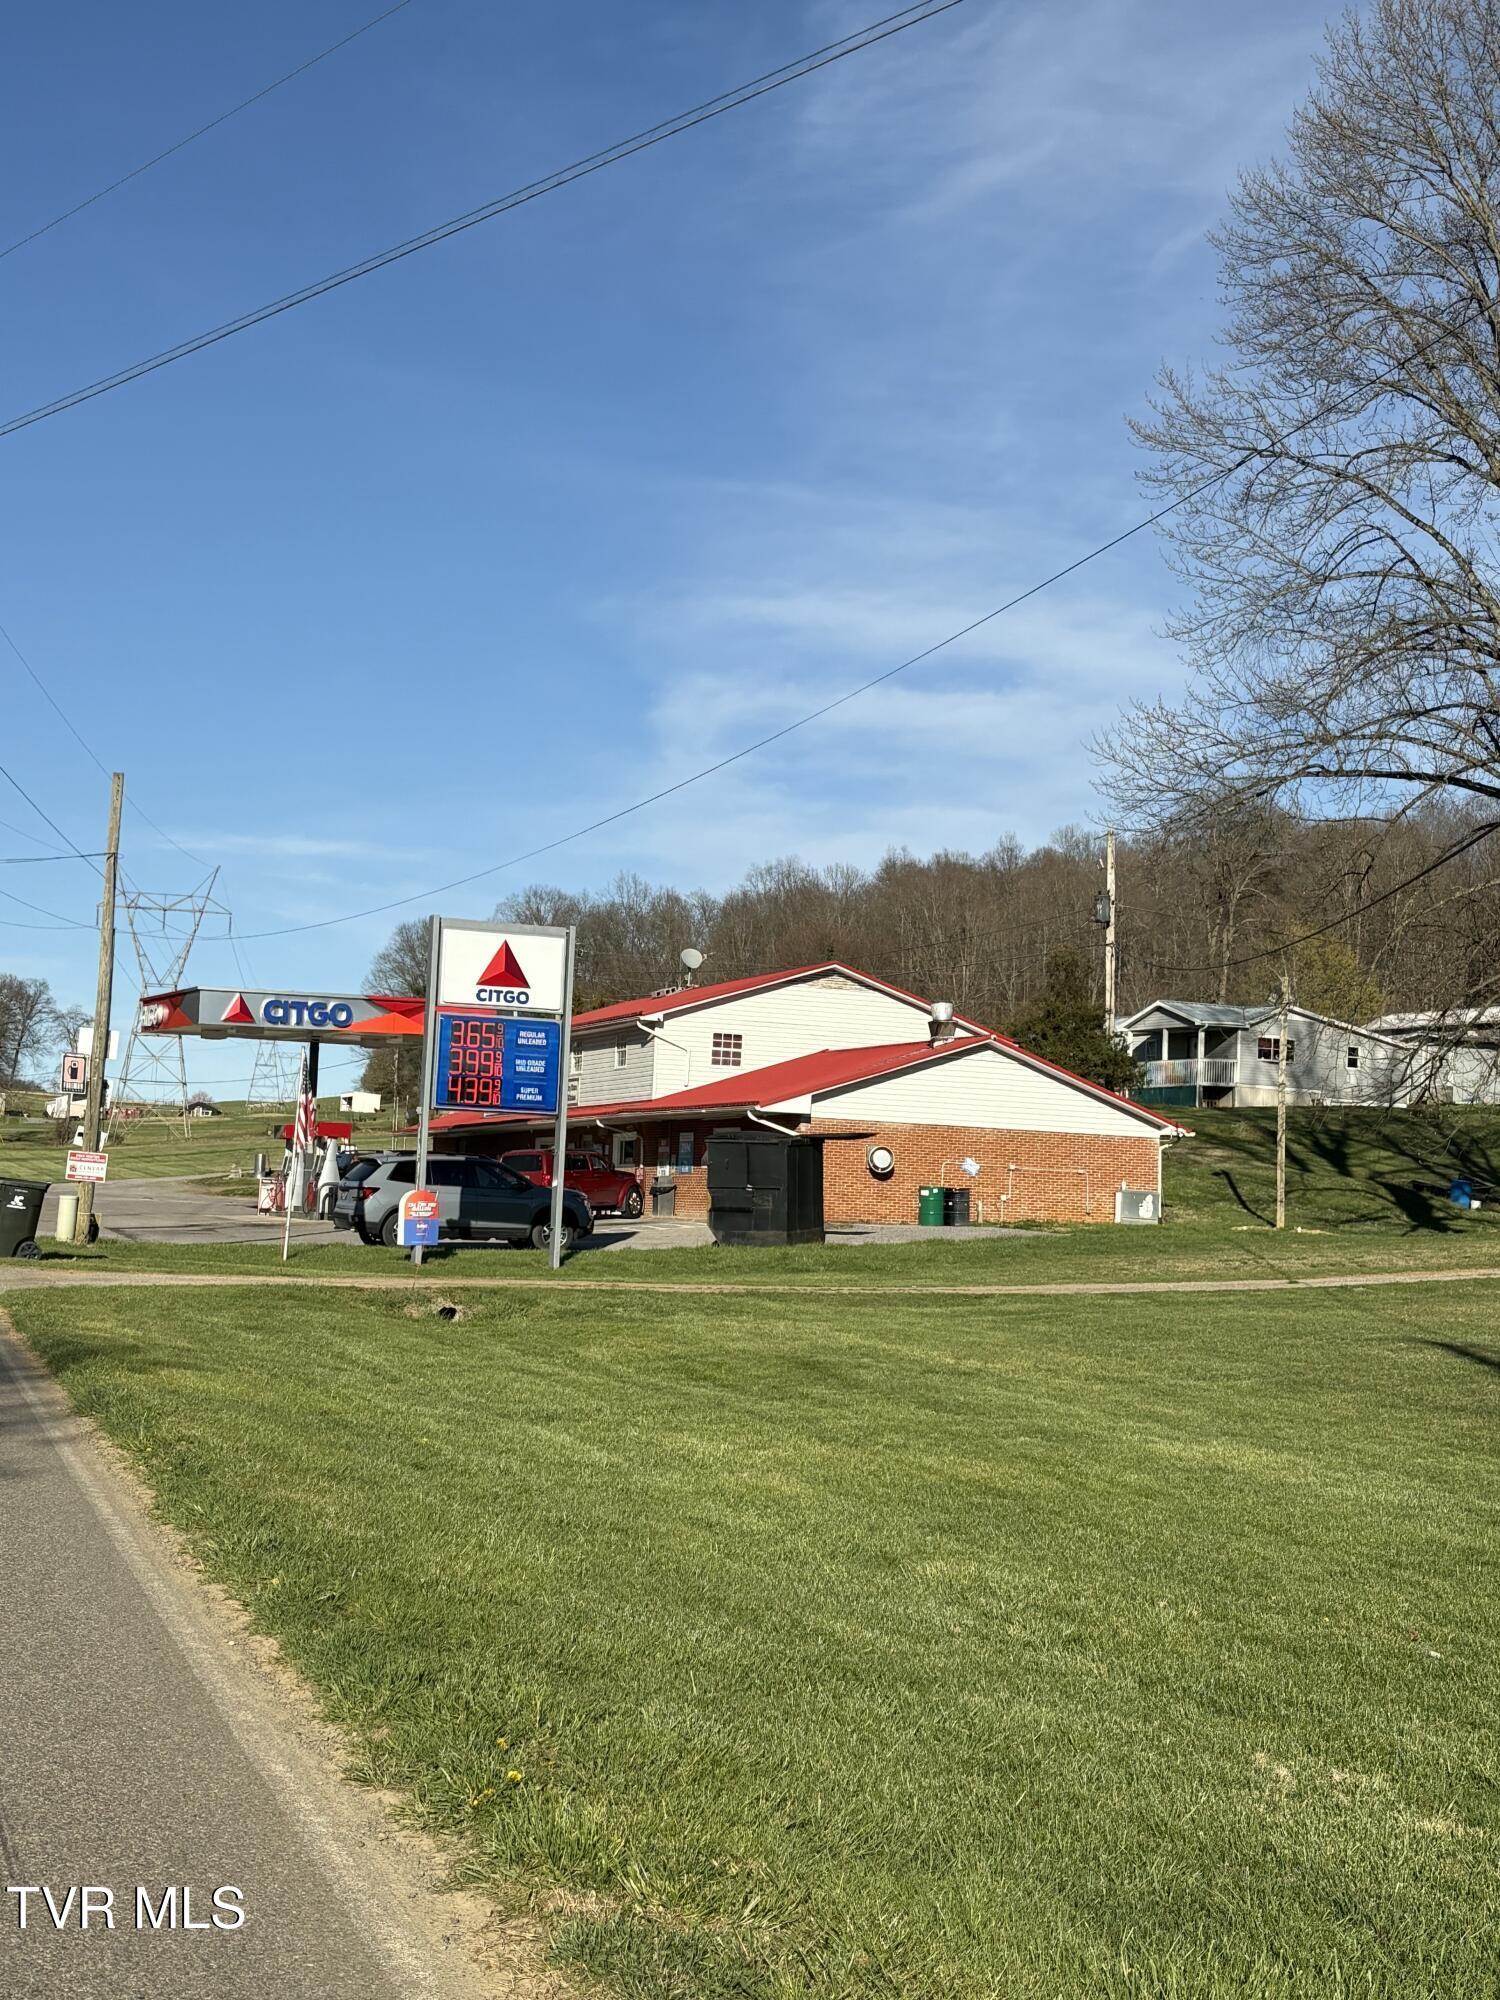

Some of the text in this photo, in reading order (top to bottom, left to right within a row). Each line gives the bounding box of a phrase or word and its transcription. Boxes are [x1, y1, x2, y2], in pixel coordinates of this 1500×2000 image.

[476, 988, 529, 1004] CITGO
[261, 999, 353, 1028] CITGO
[519, 1030, 546, 1038] REGULAR
[449, 1048, 494, 1076] 3.99
[448, 1076, 493, 1105] 4.39
[516, 1093, 543, 1102] PREMIUM
